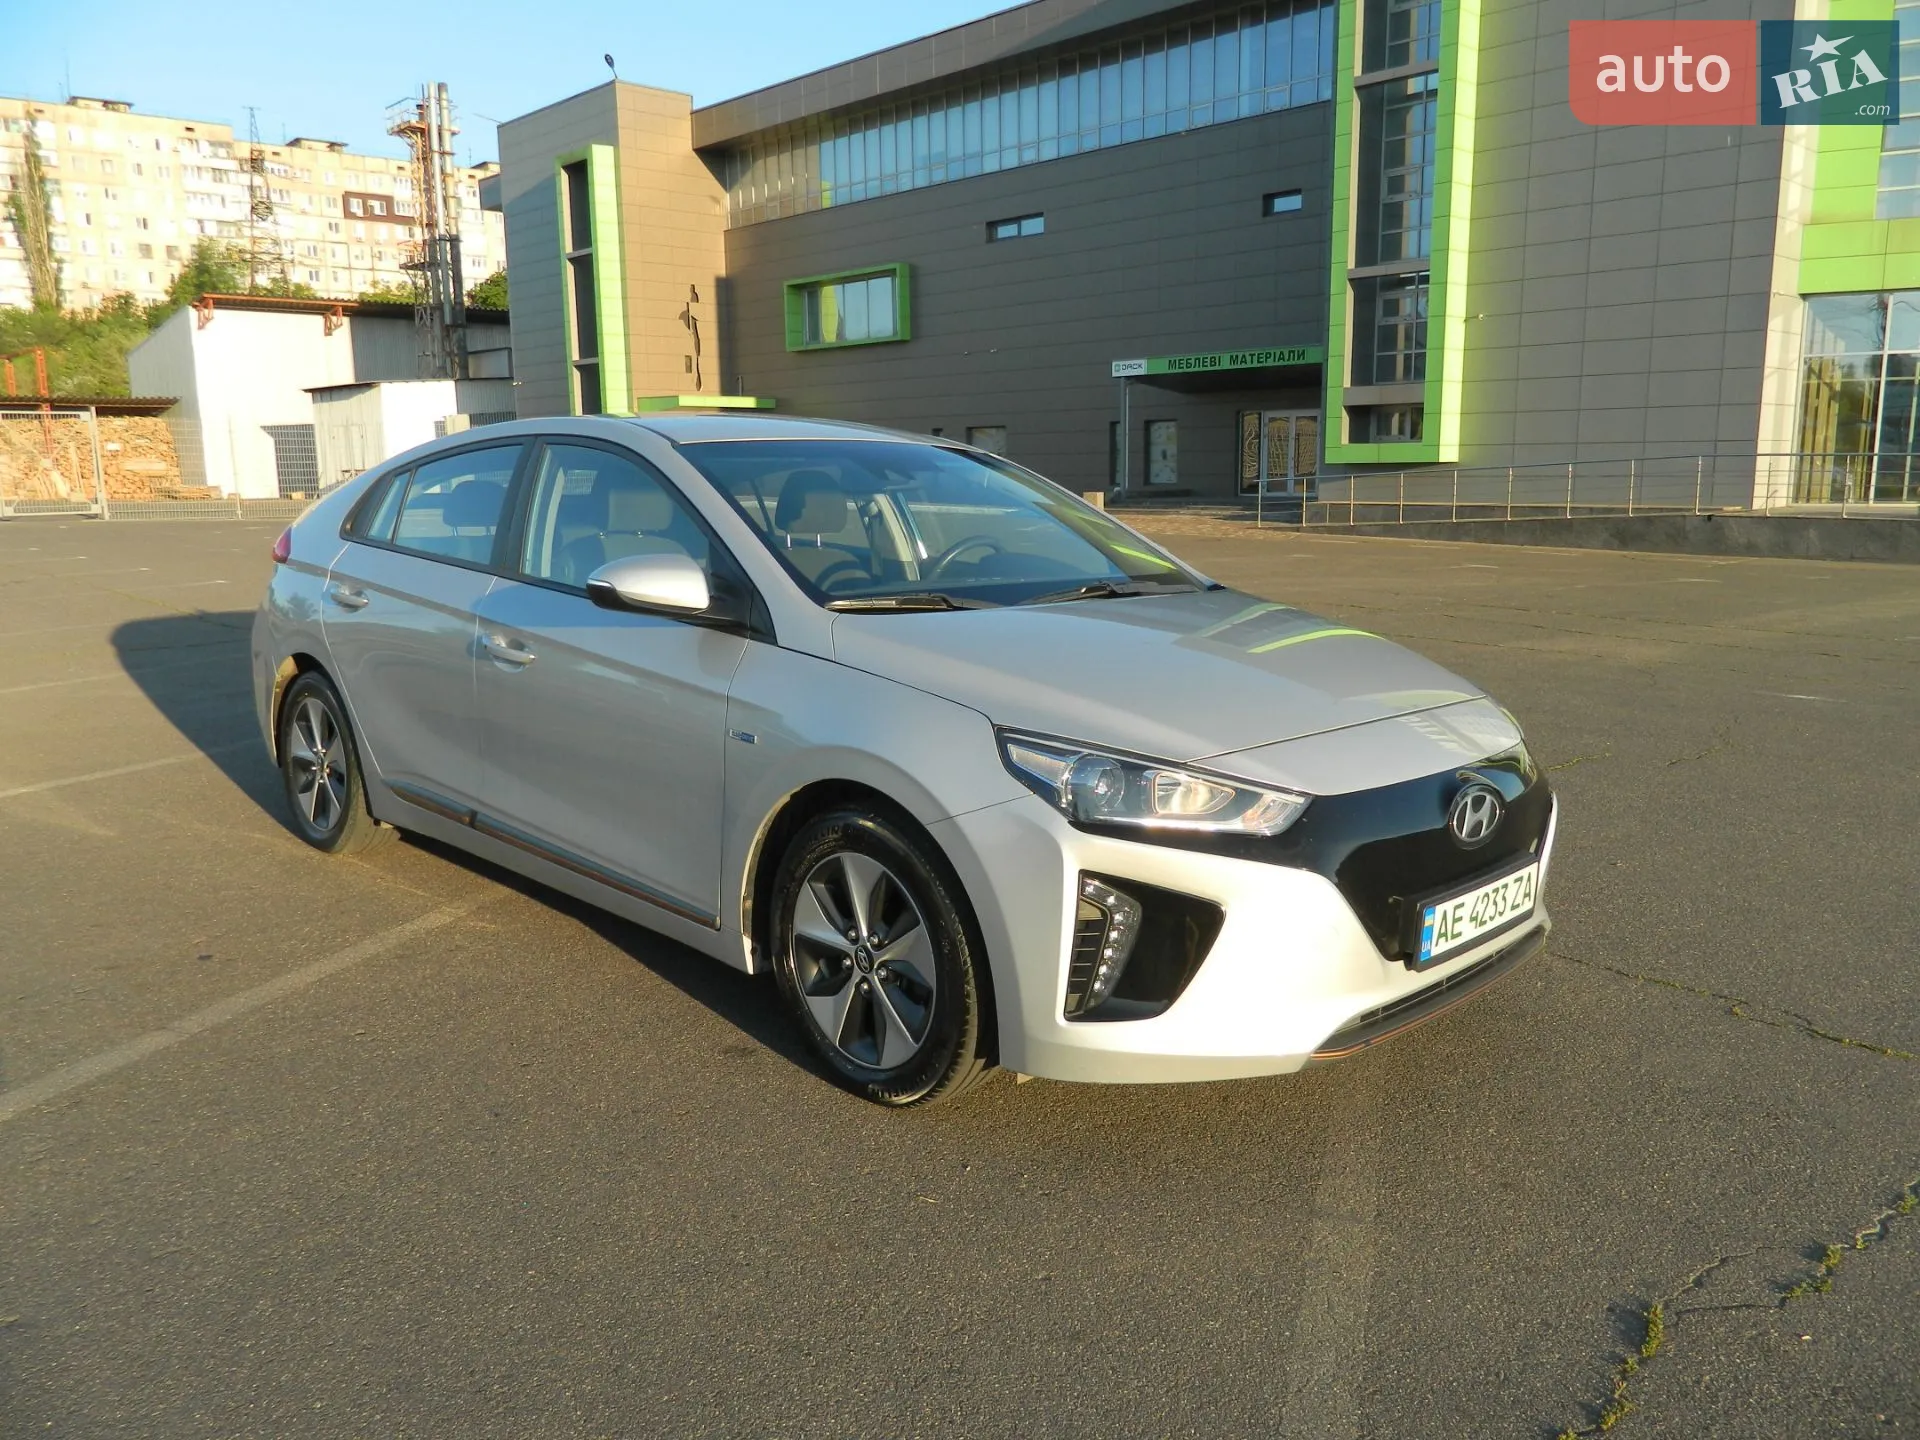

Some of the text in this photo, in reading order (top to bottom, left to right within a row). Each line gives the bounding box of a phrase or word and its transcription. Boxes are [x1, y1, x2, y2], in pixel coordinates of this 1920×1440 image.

[1168, 349, 1306, 371] МЕБЛЕВІ МАТЕРІАЛИ
[1435, 872, 1532, 947] AE 4233 ZA
